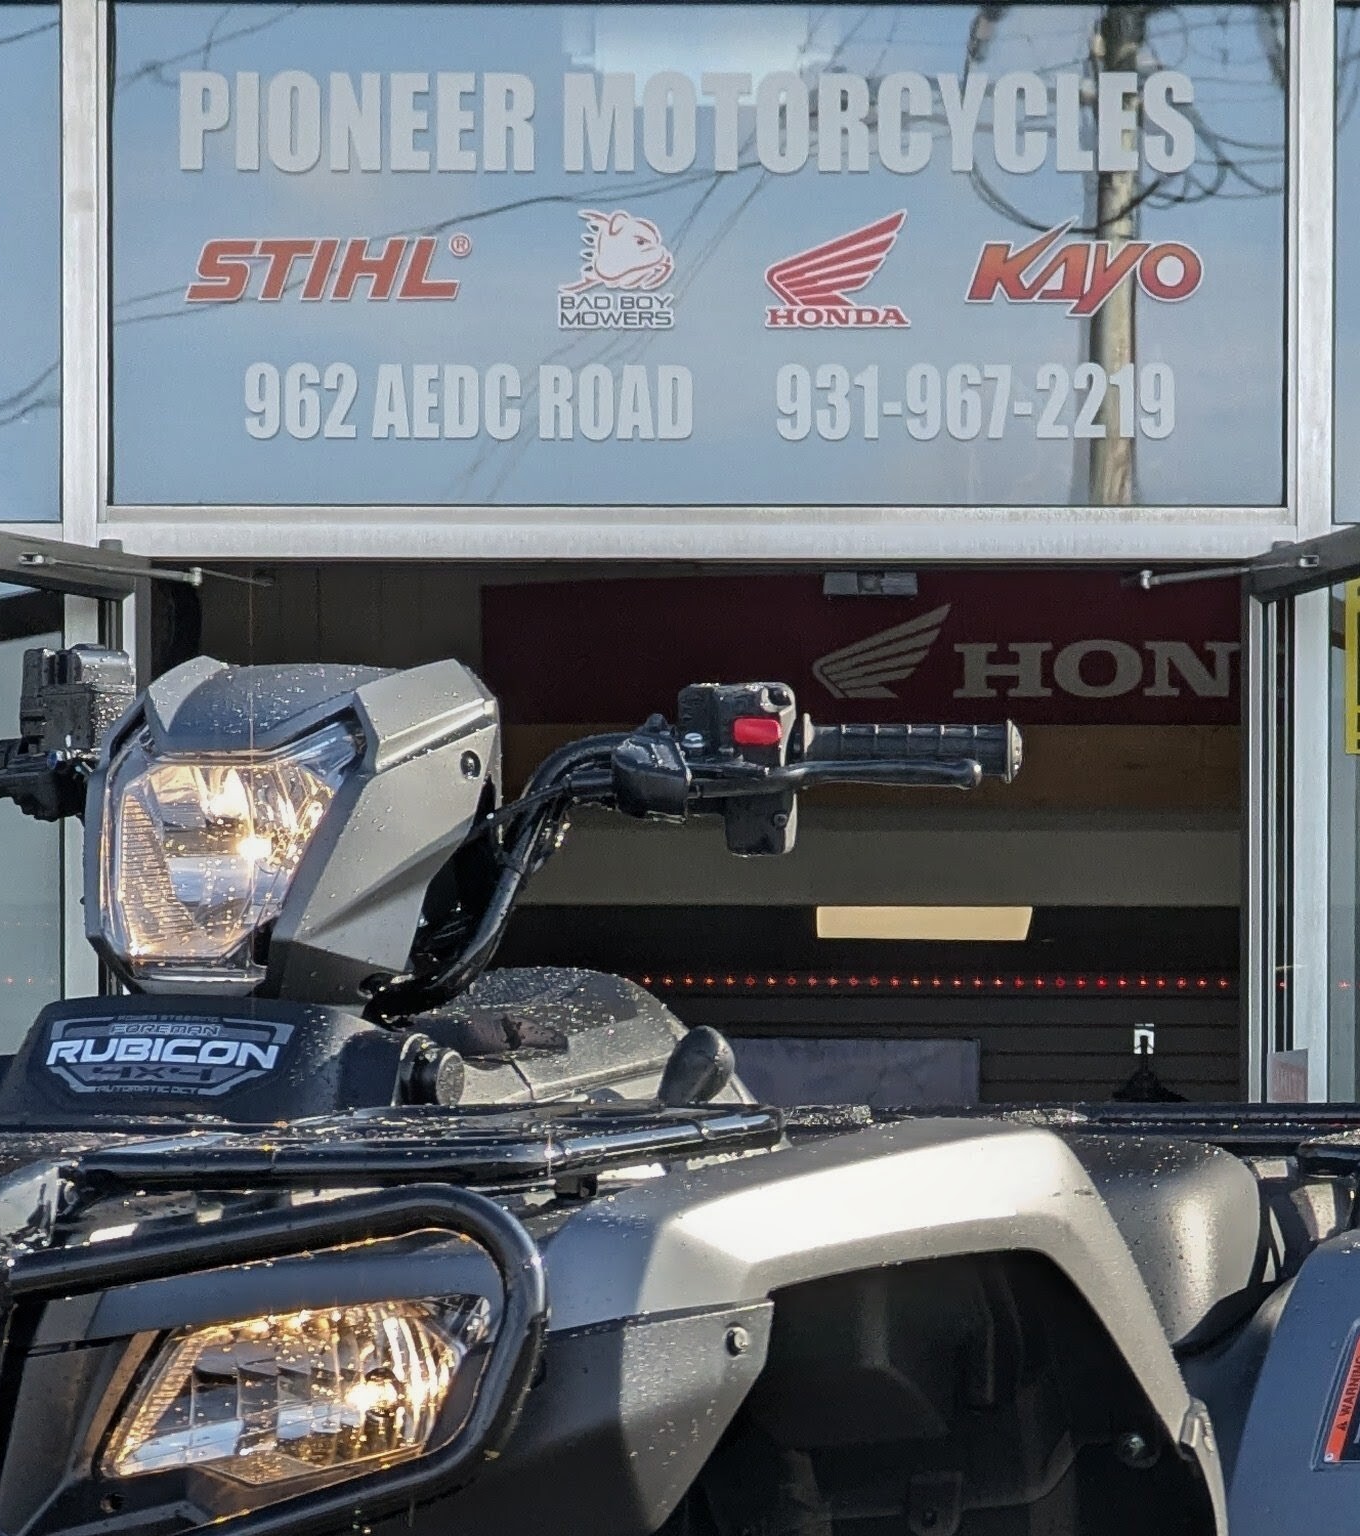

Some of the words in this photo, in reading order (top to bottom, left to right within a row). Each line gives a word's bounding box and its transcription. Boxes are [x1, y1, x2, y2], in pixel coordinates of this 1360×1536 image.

[179, 70, 535, 174] PIONEER
[562, 70, 1196, 174] MOTORCYCLES
[185, 238, 460, 303] STIHL
[966, 217, 1204, 317] KAYO
[559, 296, 611, 310] BAD
[619, 296, 671, 310] BOY
[559, 311, 672, 326] MOWERS
[766, 306, 910, 328] HONDA
[243, 363, 357, 440] 962
[372, 363, 527, 440] AEDC
[538, 363, 694, 440] ROAD
[775, 363, 1177, 440] 931-967-2219
[953, 639, 1240, 699] HON
[45, 1037, 280, 1070] RUBICON
[109, 1023, 222, 1037] FOREMAN
